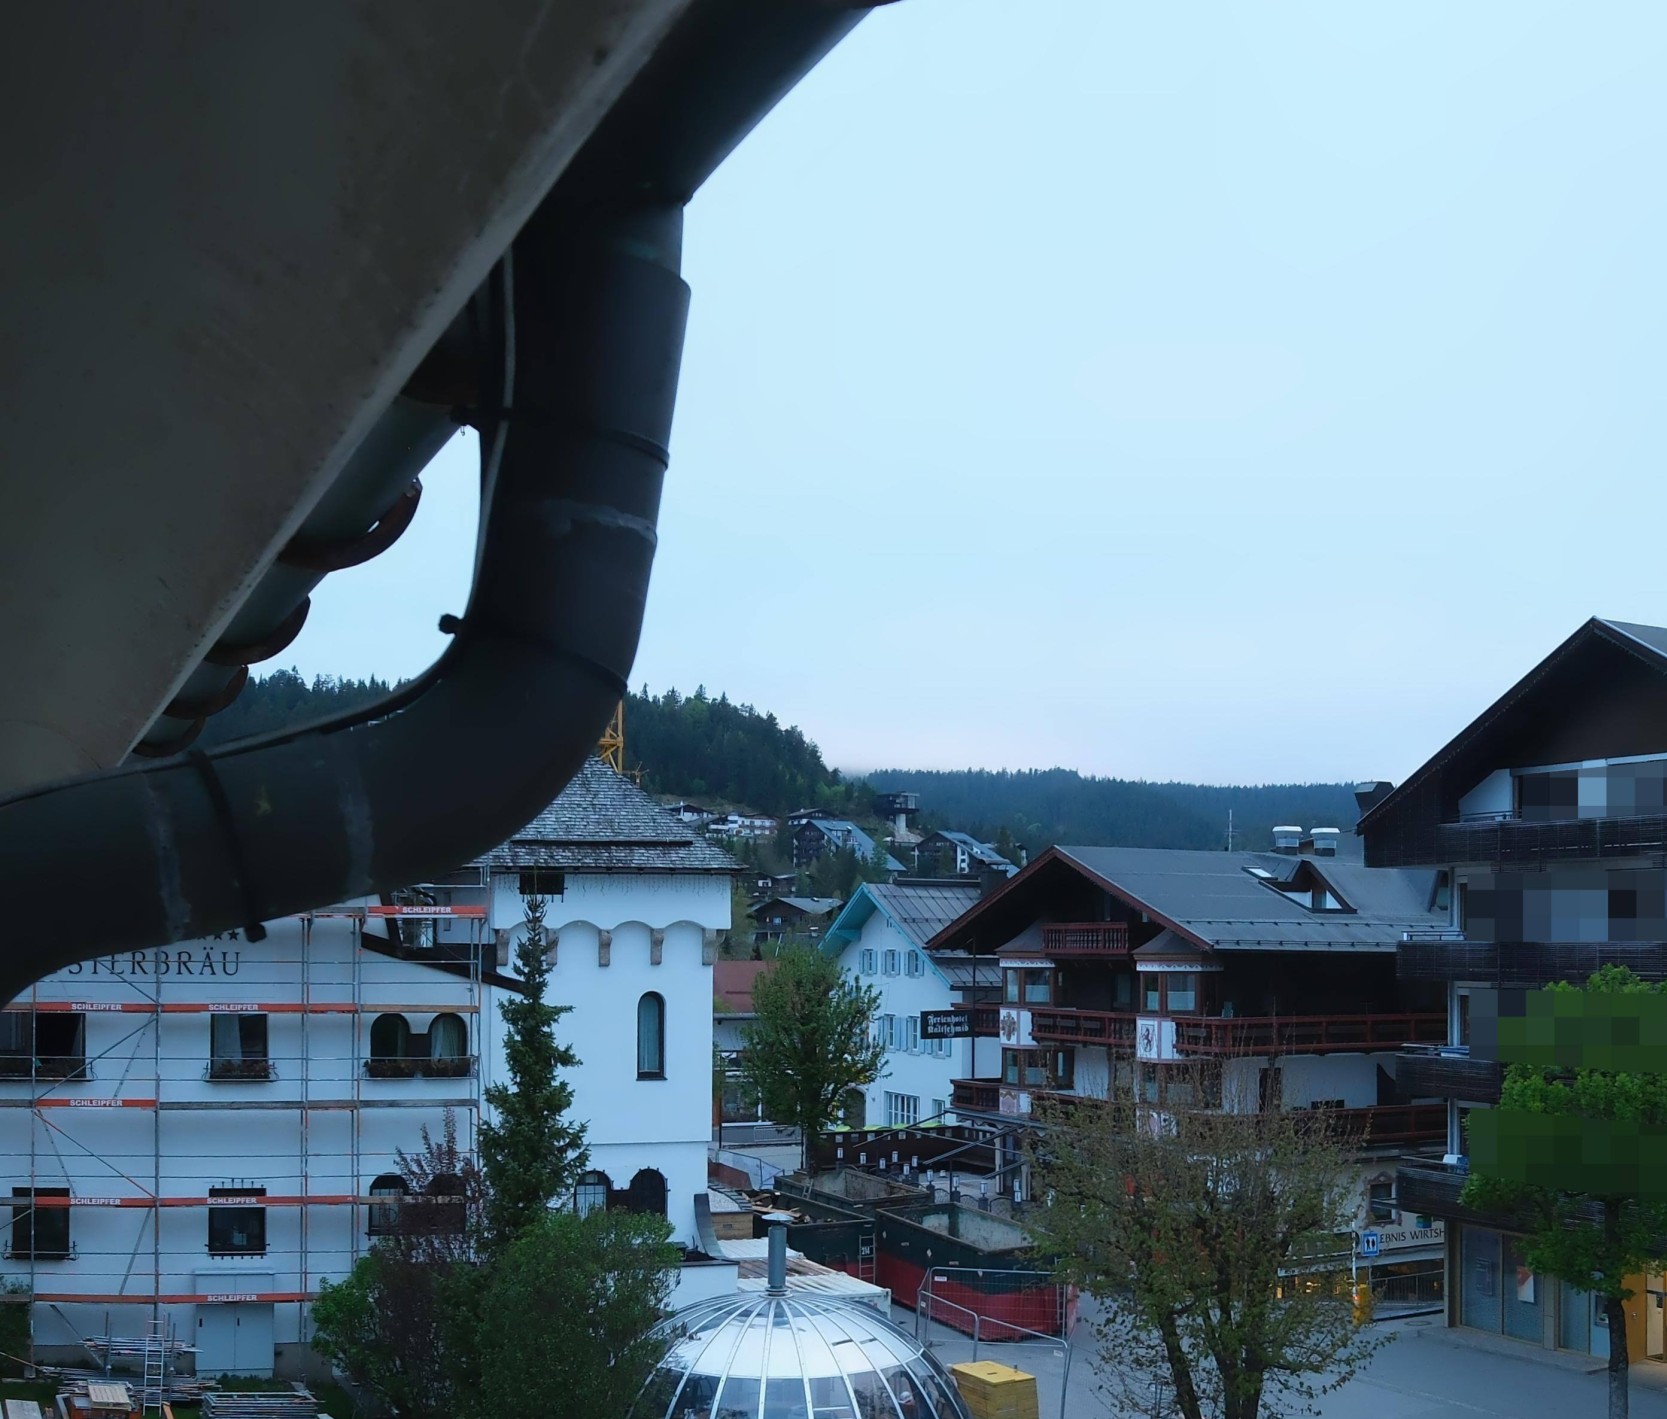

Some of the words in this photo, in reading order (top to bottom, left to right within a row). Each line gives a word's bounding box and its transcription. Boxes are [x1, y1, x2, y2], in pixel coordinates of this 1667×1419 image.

[402, 906, 451, 914] SCHLEIPFER
[72, 1003, 122, 1011] SCHLEIPFER
[208, 1003, 258, 1011] SCHLEIPFER
